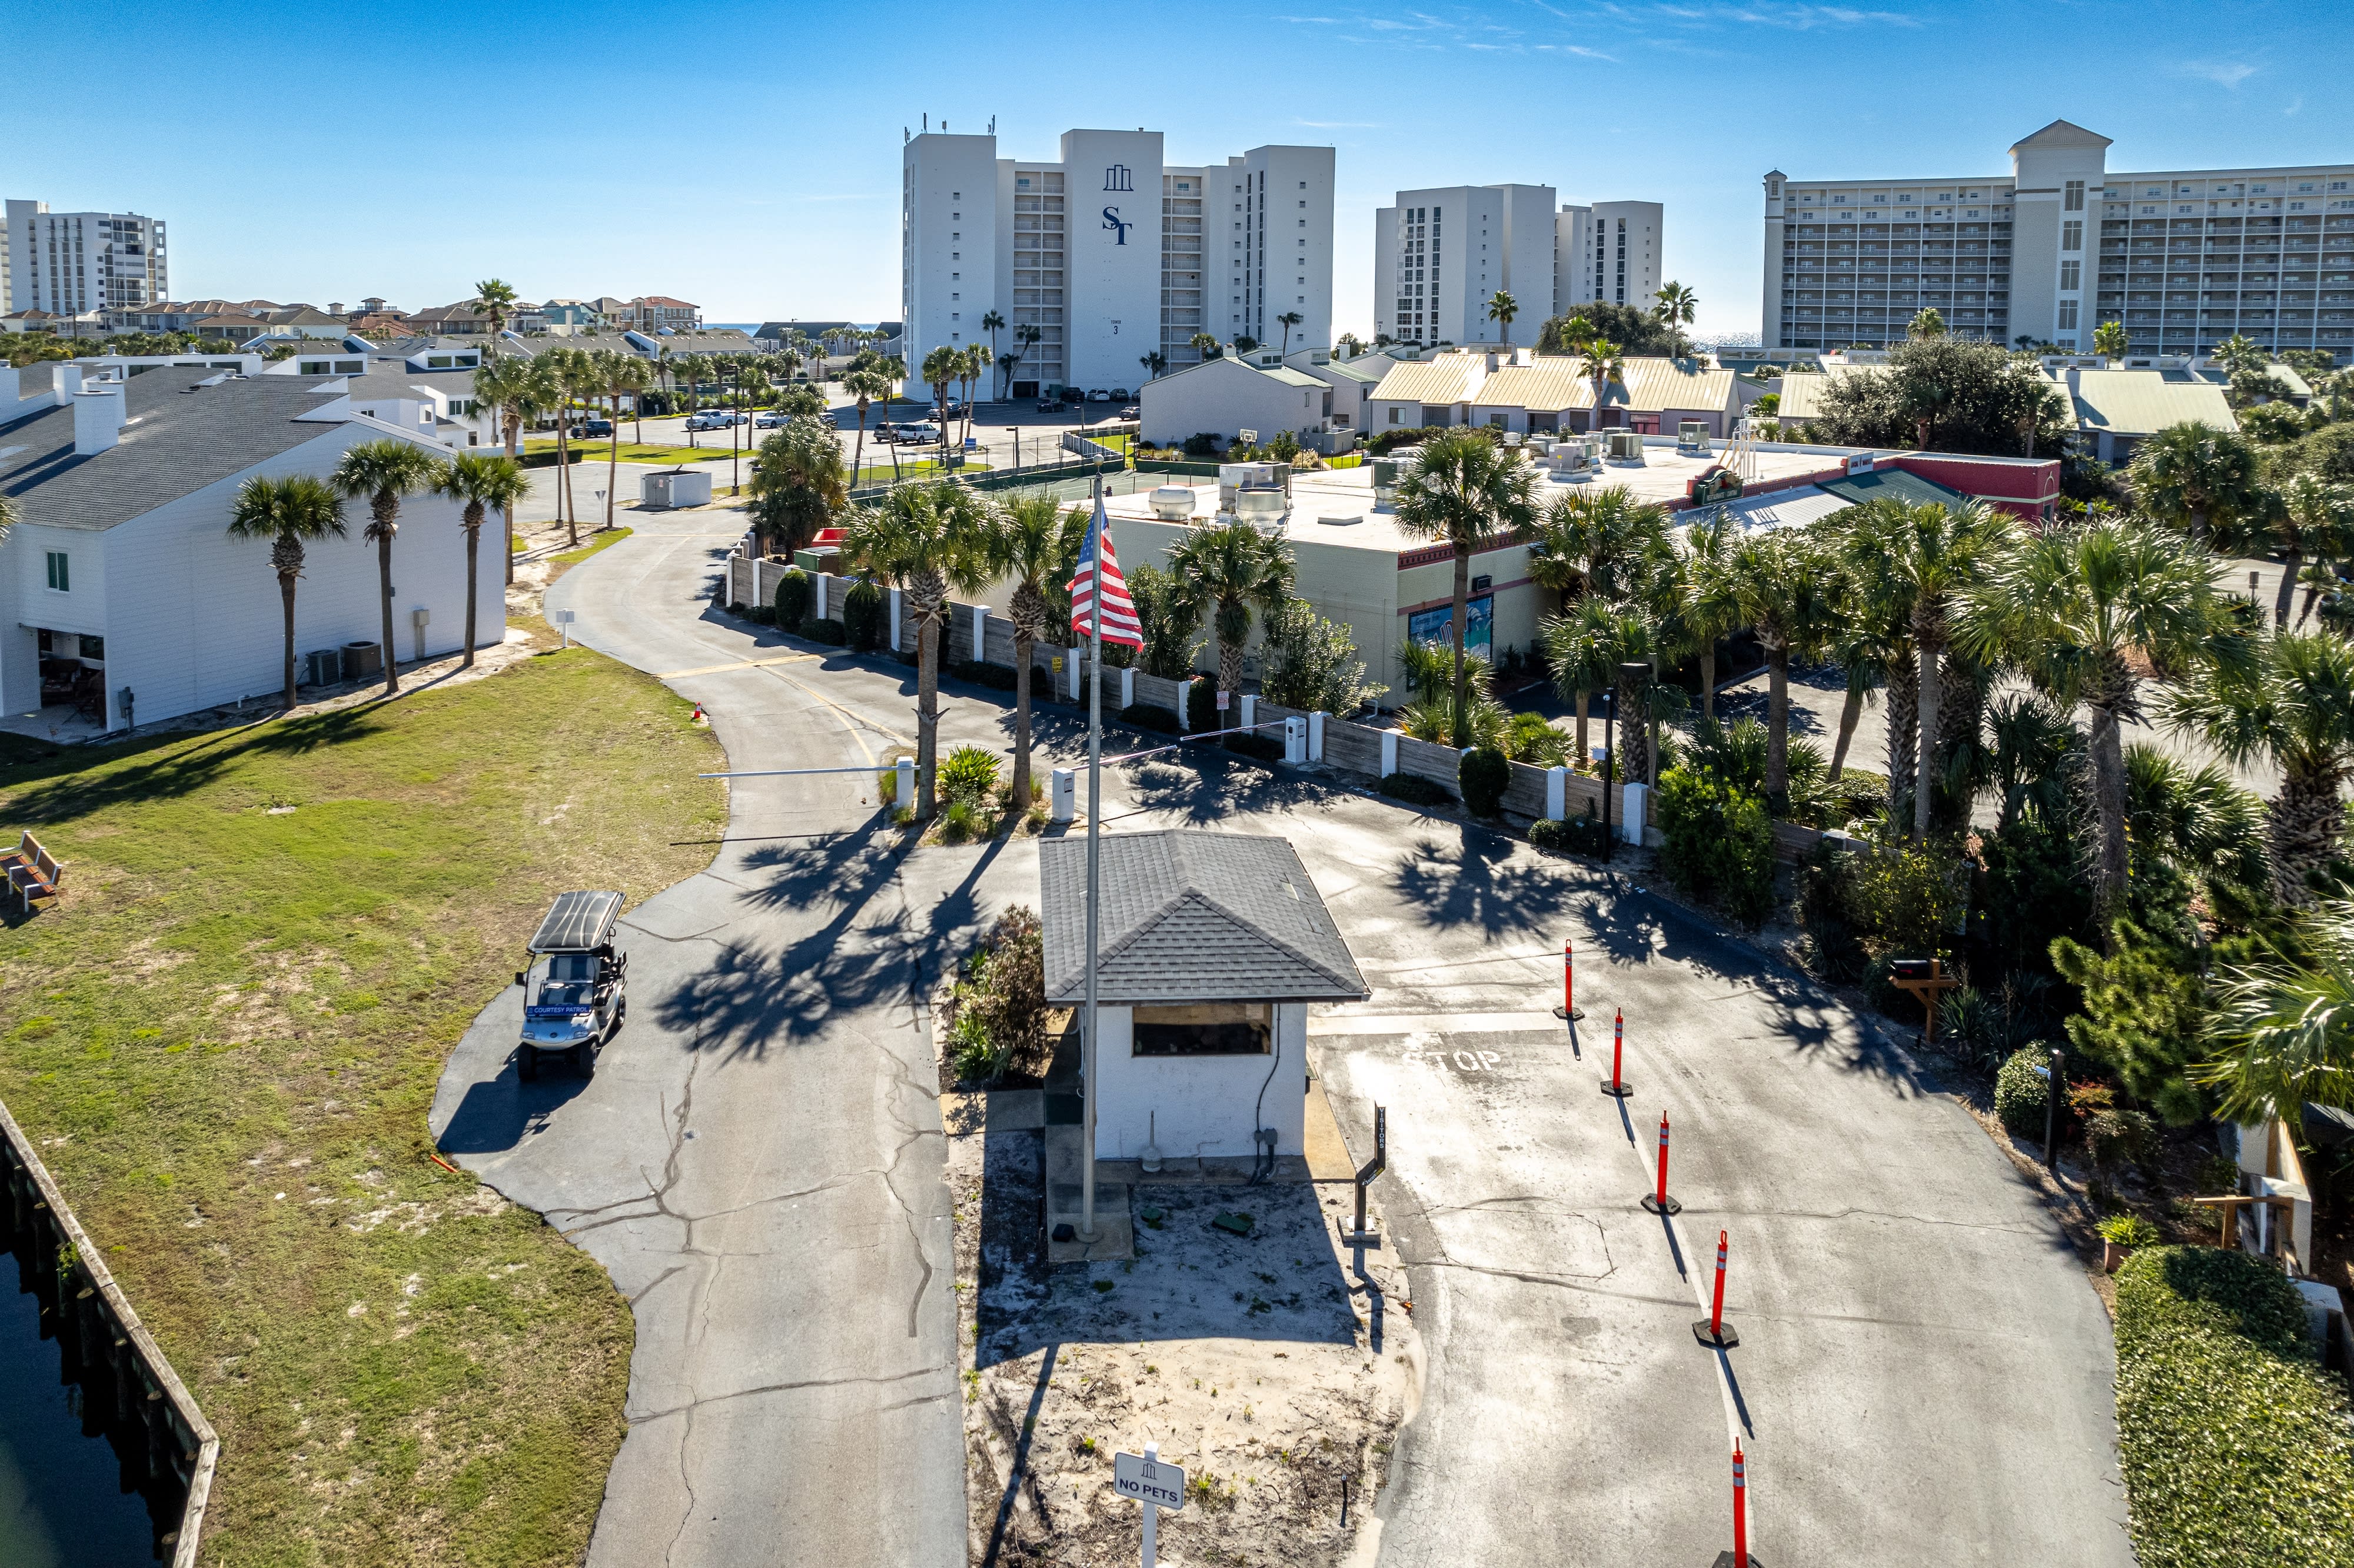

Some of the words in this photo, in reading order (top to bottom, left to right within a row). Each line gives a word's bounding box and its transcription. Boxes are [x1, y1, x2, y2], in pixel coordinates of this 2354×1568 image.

[1113, 325, 1118, 334] 3
[1401, 1050, 1501, 1072] STOP
[1119, 1478, 1139, 1492] NO
[1143, 1484, 1178, 1502] PETS
